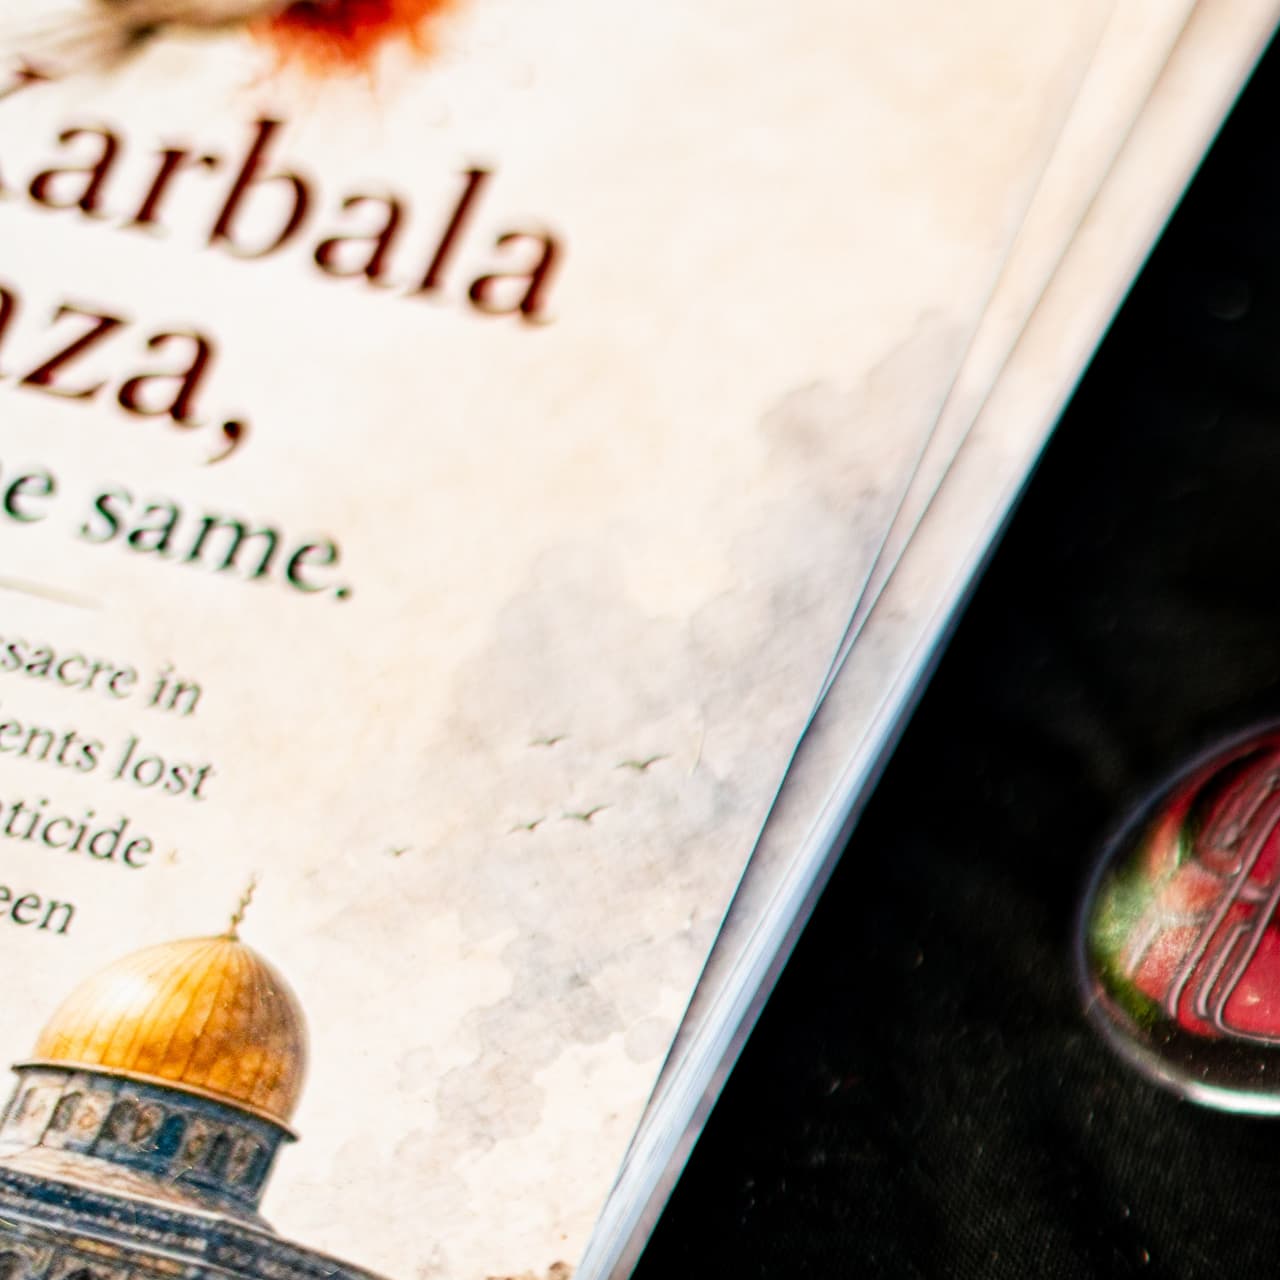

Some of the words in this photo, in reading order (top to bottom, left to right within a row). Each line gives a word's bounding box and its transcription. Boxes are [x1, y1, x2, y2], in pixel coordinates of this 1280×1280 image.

[0, 113, 565, 328] arbala
[80, 487, 354, 600] same.
[0, 637, 138, 699] sacre
[147, 660, 202, 716] in
[112, 735, 215, 800] lost
[0, 798, 154, 870] ticide
